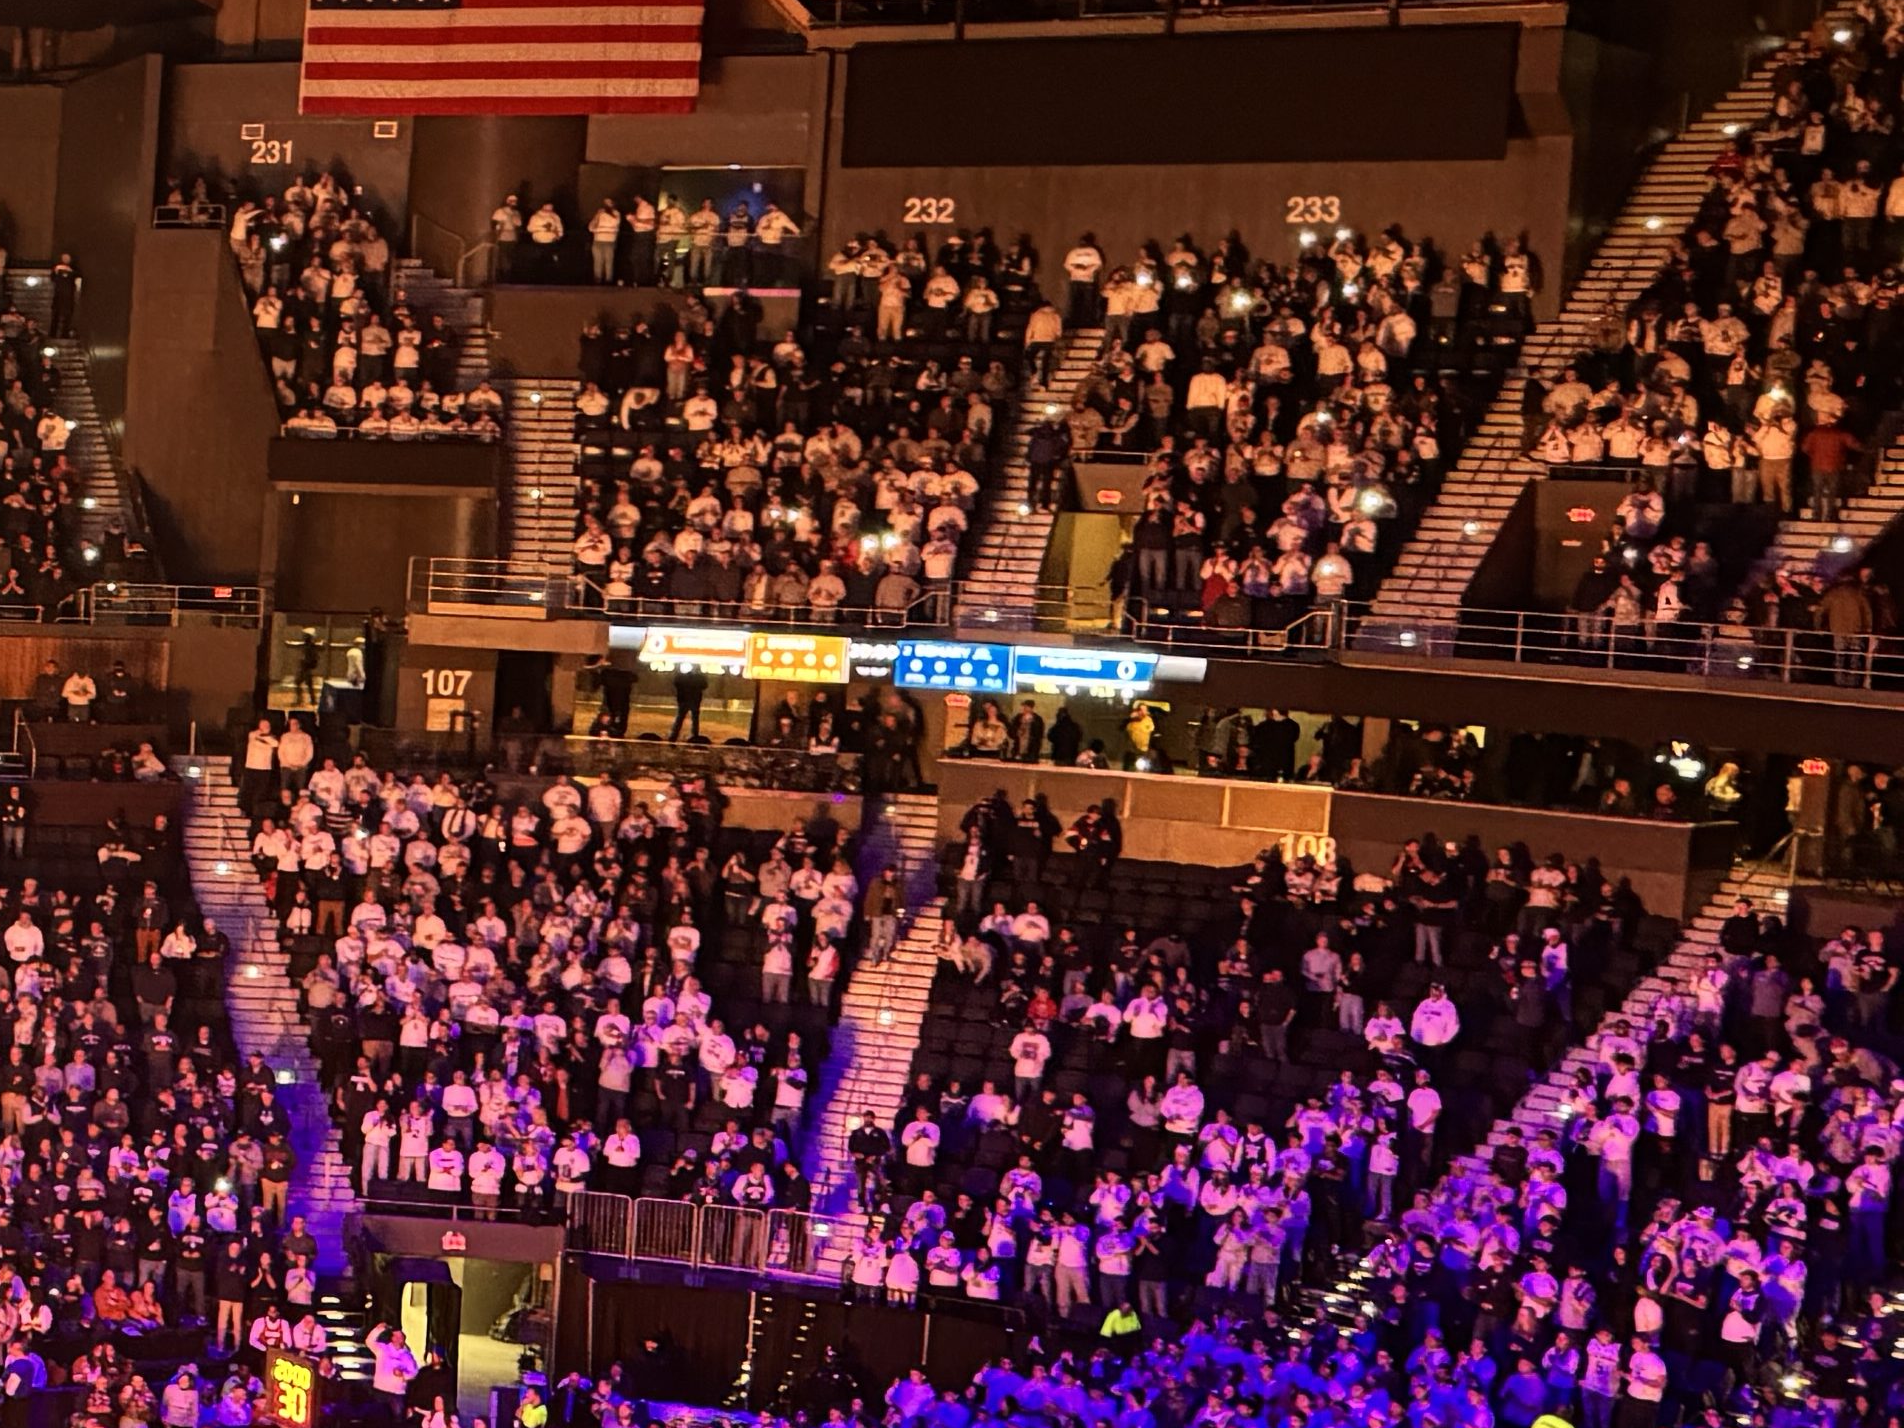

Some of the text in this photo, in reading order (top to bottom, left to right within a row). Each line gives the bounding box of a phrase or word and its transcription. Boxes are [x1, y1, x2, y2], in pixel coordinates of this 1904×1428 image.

[251, 140, 293, 164] 231
[903, 197, 955, 223] 232
[1285, 196, 1340, 223] 233
[422, 669, 473, 696] 107
[1279, 833, 1336, 866] 108
[278, 1383, 306, 1424] 30
